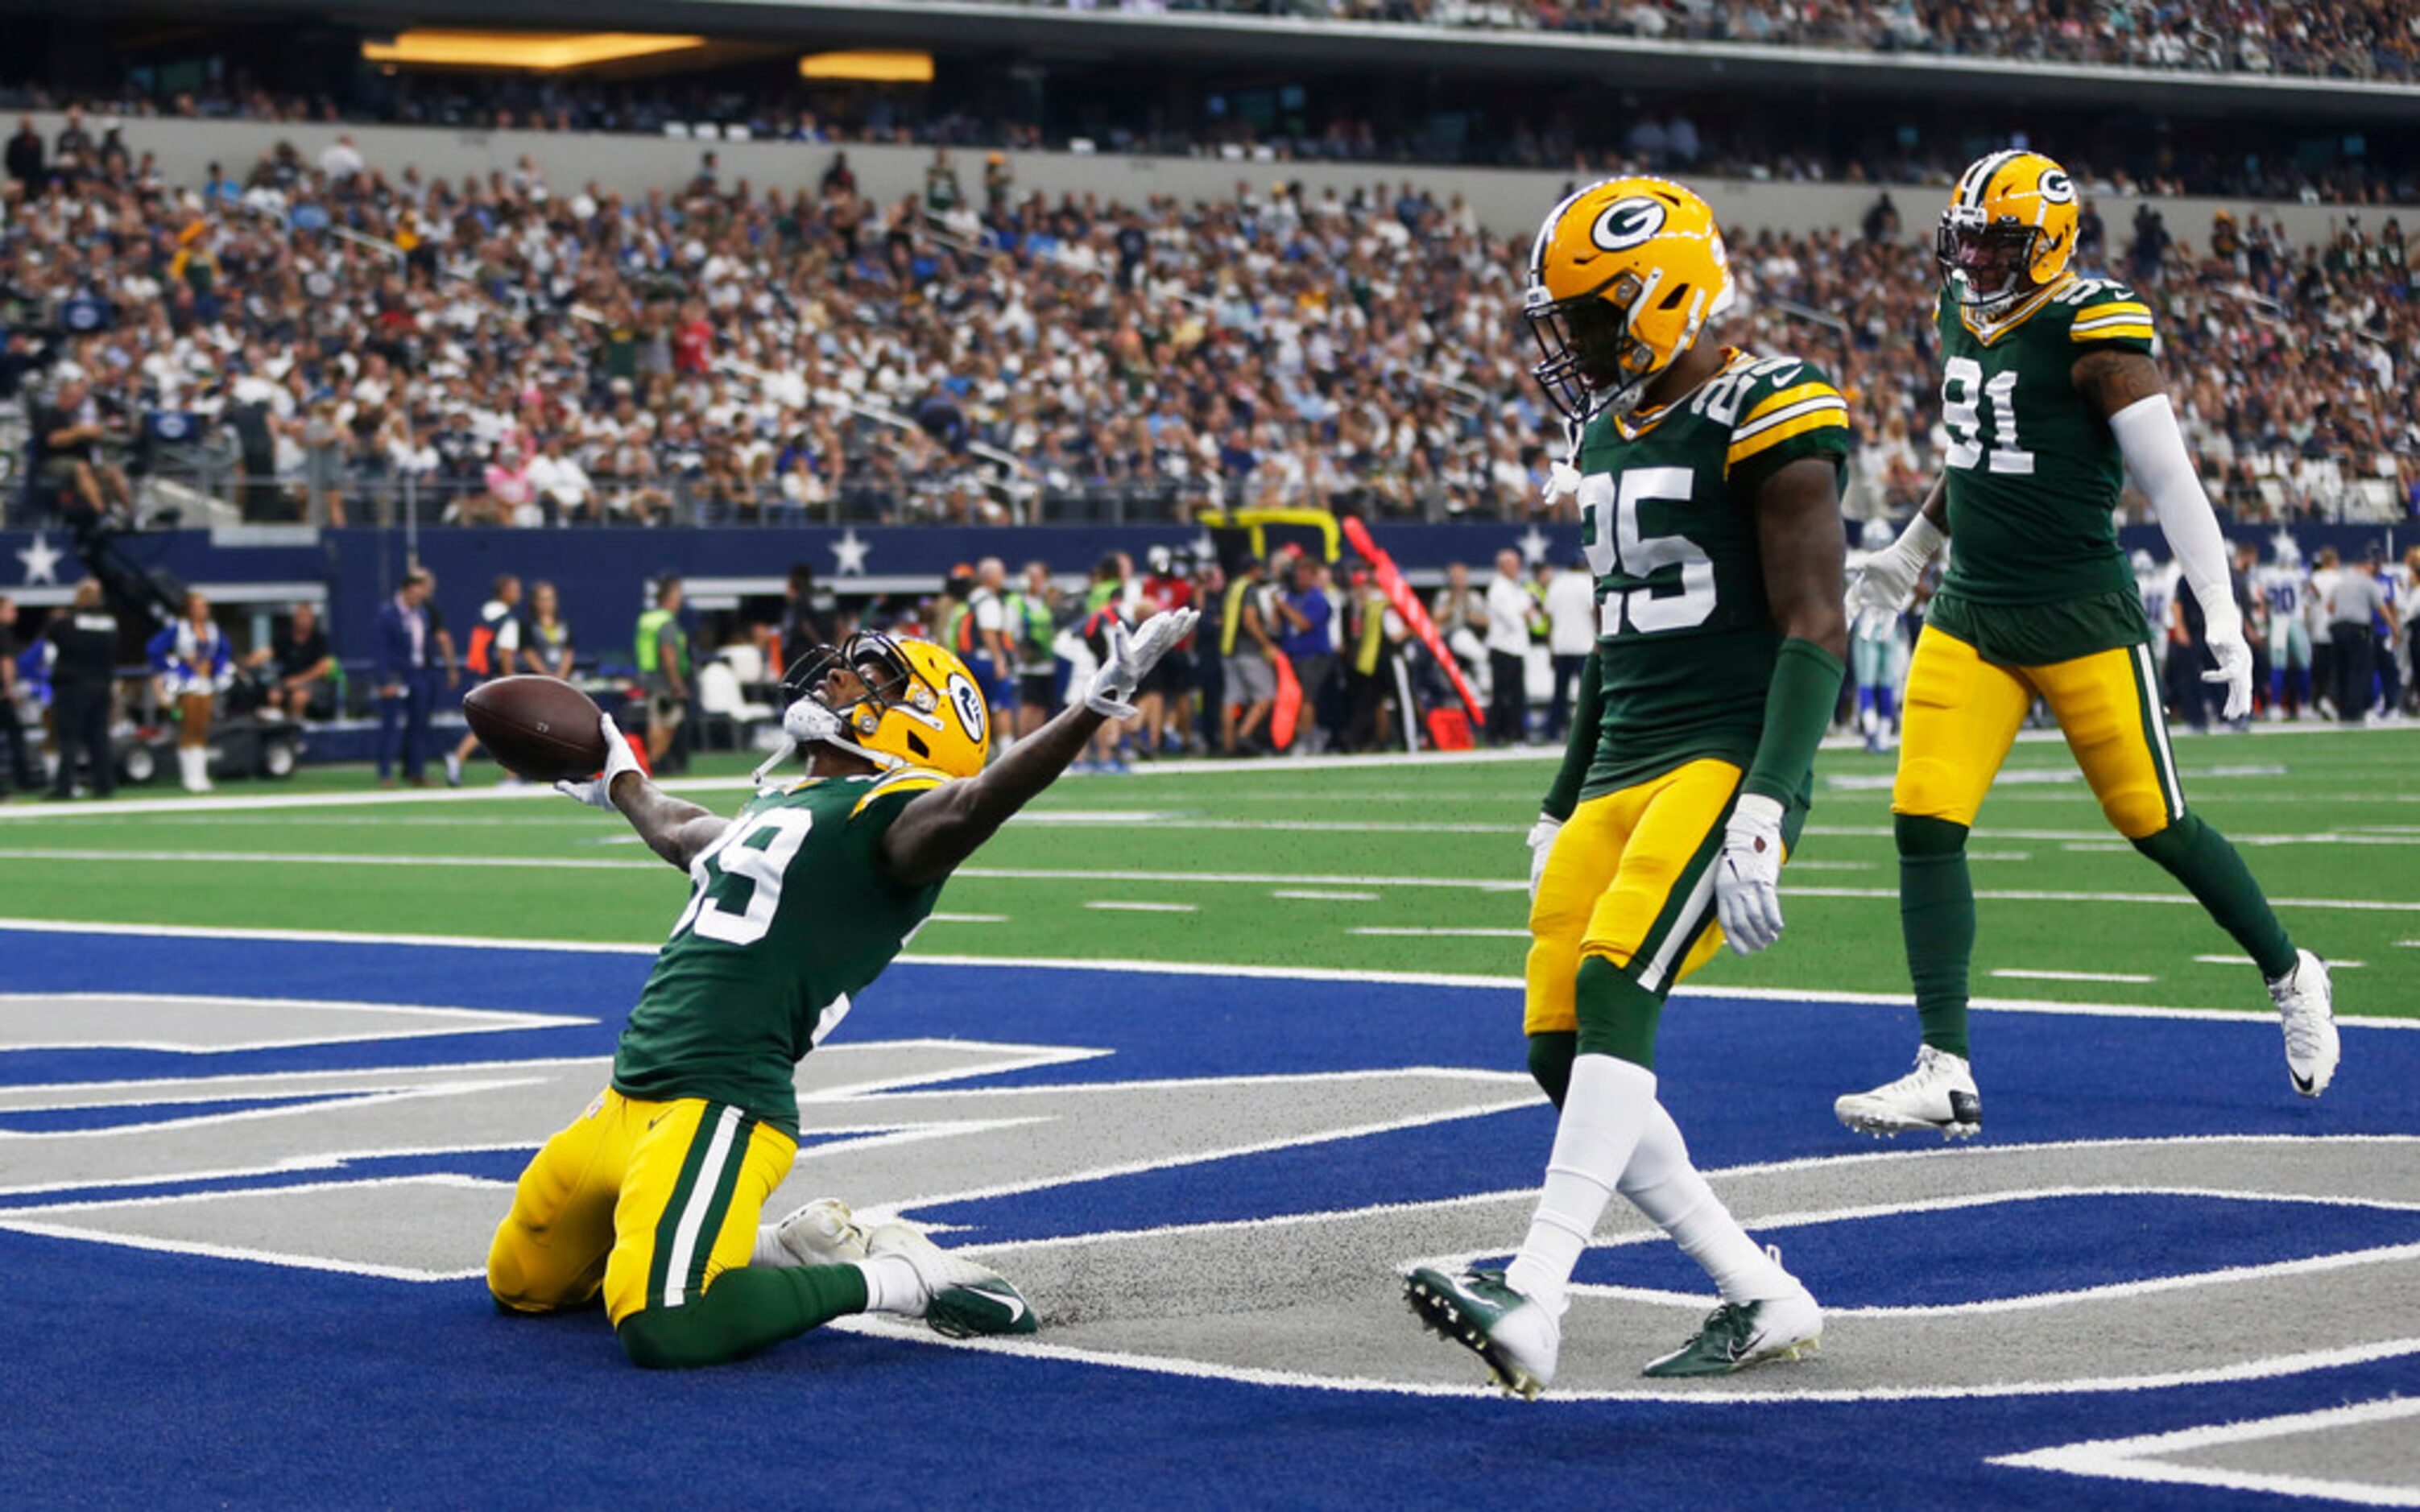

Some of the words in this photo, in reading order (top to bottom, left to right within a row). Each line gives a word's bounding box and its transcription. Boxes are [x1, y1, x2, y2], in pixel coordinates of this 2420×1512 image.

[1590, 196, 1667, 253] G
[2038, 168, 2076, 204] G
[1941, 355, 2035, 474] 91
[1576, 466, 1718, 634] 25
